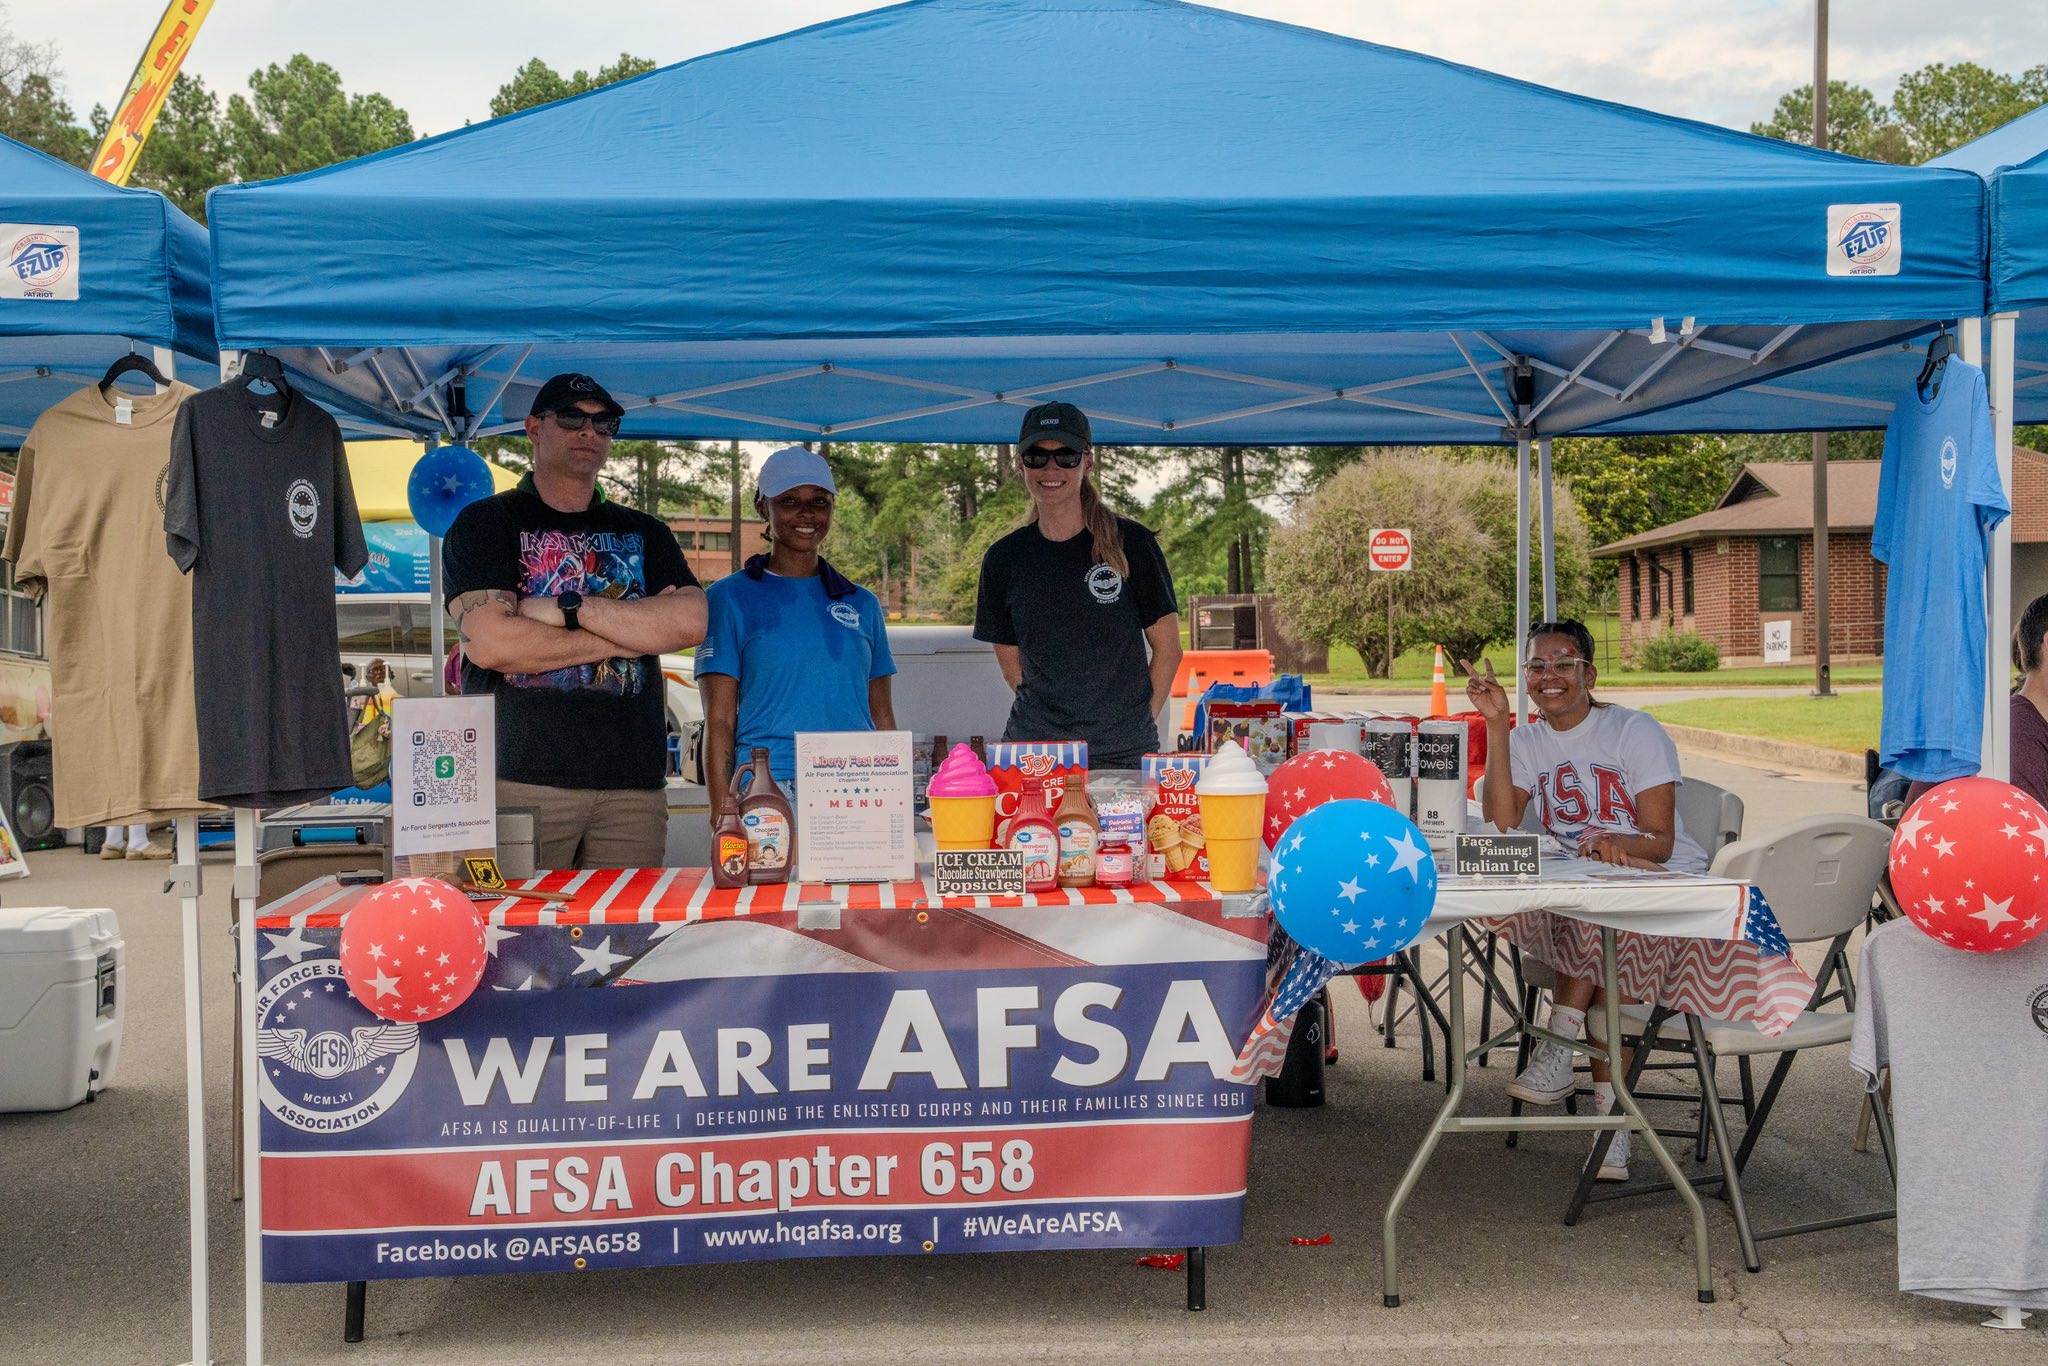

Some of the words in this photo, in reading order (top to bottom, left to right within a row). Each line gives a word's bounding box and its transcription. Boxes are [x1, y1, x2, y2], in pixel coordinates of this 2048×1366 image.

[520, 531, 570, 555] IRON
[1376, 537, 1386, 545] DO
[1389, 537, 1404, 545] NOT
[1379, 555, 1402, 563] ENTER
[1772, 630, 1781, 640] NO
[813, 755, 847, 770] Liberty
[849, 755, 871, 767] Fest
[873, 755, 899, 767] 2025
[1419, 758, 1454, 770] owels
[1042, 776, 1064, 788] CRE
[829, 799, 883, 808] MENU
[1164, 807, 1192, 815] CUPS
[1427, 810, 1439, 819] 88
[428, 822, 457, 830] Sergeants
[458, 819, 490, 827] Association
[1461, 837, 1493, 847] Face
[1480, 846, 1532, 857] Painting!
[937, 853, 963, 867] ICE
[967, 852, 1022, 867] CREAM
[1459, 860, 1509, 872] Italian
[1513, 860, 1536, 872] Ice
[937, 866, 974, 880] Chocolate
[974, 865, 1023, 880] Strawberries
[939, 879, 1022, 894] Popsicles
[270, 964, 322, 996] FORCE
[442, 1032, 610, 1107] WE
[632, 1022, 832, 1101] ARE
[857, 979, 1240, 1092] AFSA
[308, 1038, 349, 1068] AFSA
[303, 1092, 353, 1105] MCMLXI
[277, 1101, 381, 1130] ASSOCIATION
[441, 1121, 483, 1137] AFSA
[492, 1119, 507, 1135] IS
[518, 1114, 661, 1135] QUALITY-OF-LIFE
[697, 1106, 787, 1126] DEFENDING
[795, 1104, 826, 1120] THE
[833, 1102, 910, 1119] ENLISTED
[918, 1102, 972, 1118] CORPS
[981, 1101, 1012, 1116] AND
[1021, 1098, 1067, 1115] THEIR
[1076, 1095, 1149, 1112] FAMILIES
[1157, 1093, 1205, 1109] SINCE
[1213, 1091, 1246, 1107] 1961
[468, 1155, 634, 1218] AFSA
[655, 1145, 899, 1213] Chapter
[920, 1139, 1036, 1197] 658
[376, 1238, 498, 1264] Facebook
[505, 1231, 642, 1260] @AFSA658
[704, 1217, 903, 1247] www.hqafsa.org
[963, 1210, 1123, 1238] #WeAreAFSA
